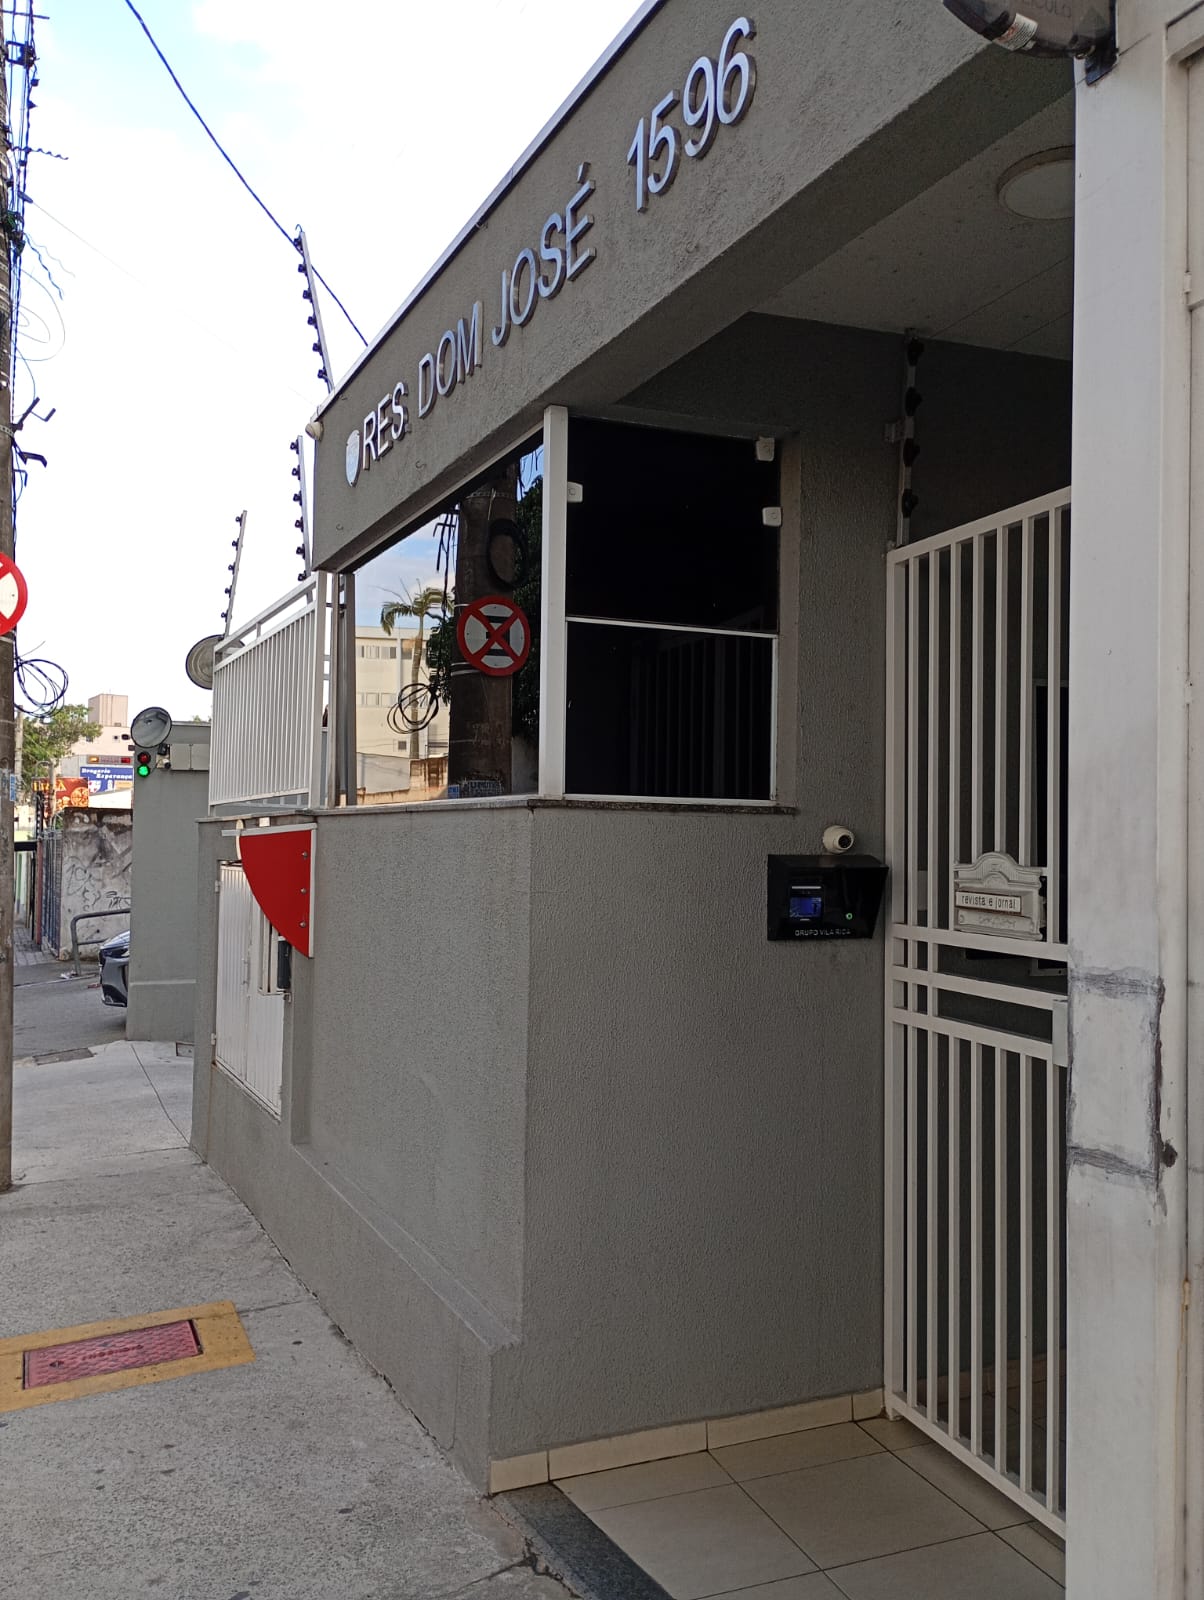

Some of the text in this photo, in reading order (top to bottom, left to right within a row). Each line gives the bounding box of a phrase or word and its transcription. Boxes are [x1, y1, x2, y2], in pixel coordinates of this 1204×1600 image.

[418, 300, 484, 420] DOM
[491, 162, 596, 347] JOSÉ
[627, 16, 756, 214] 1596
[961, 895, 1016, 910] revista e jornal
